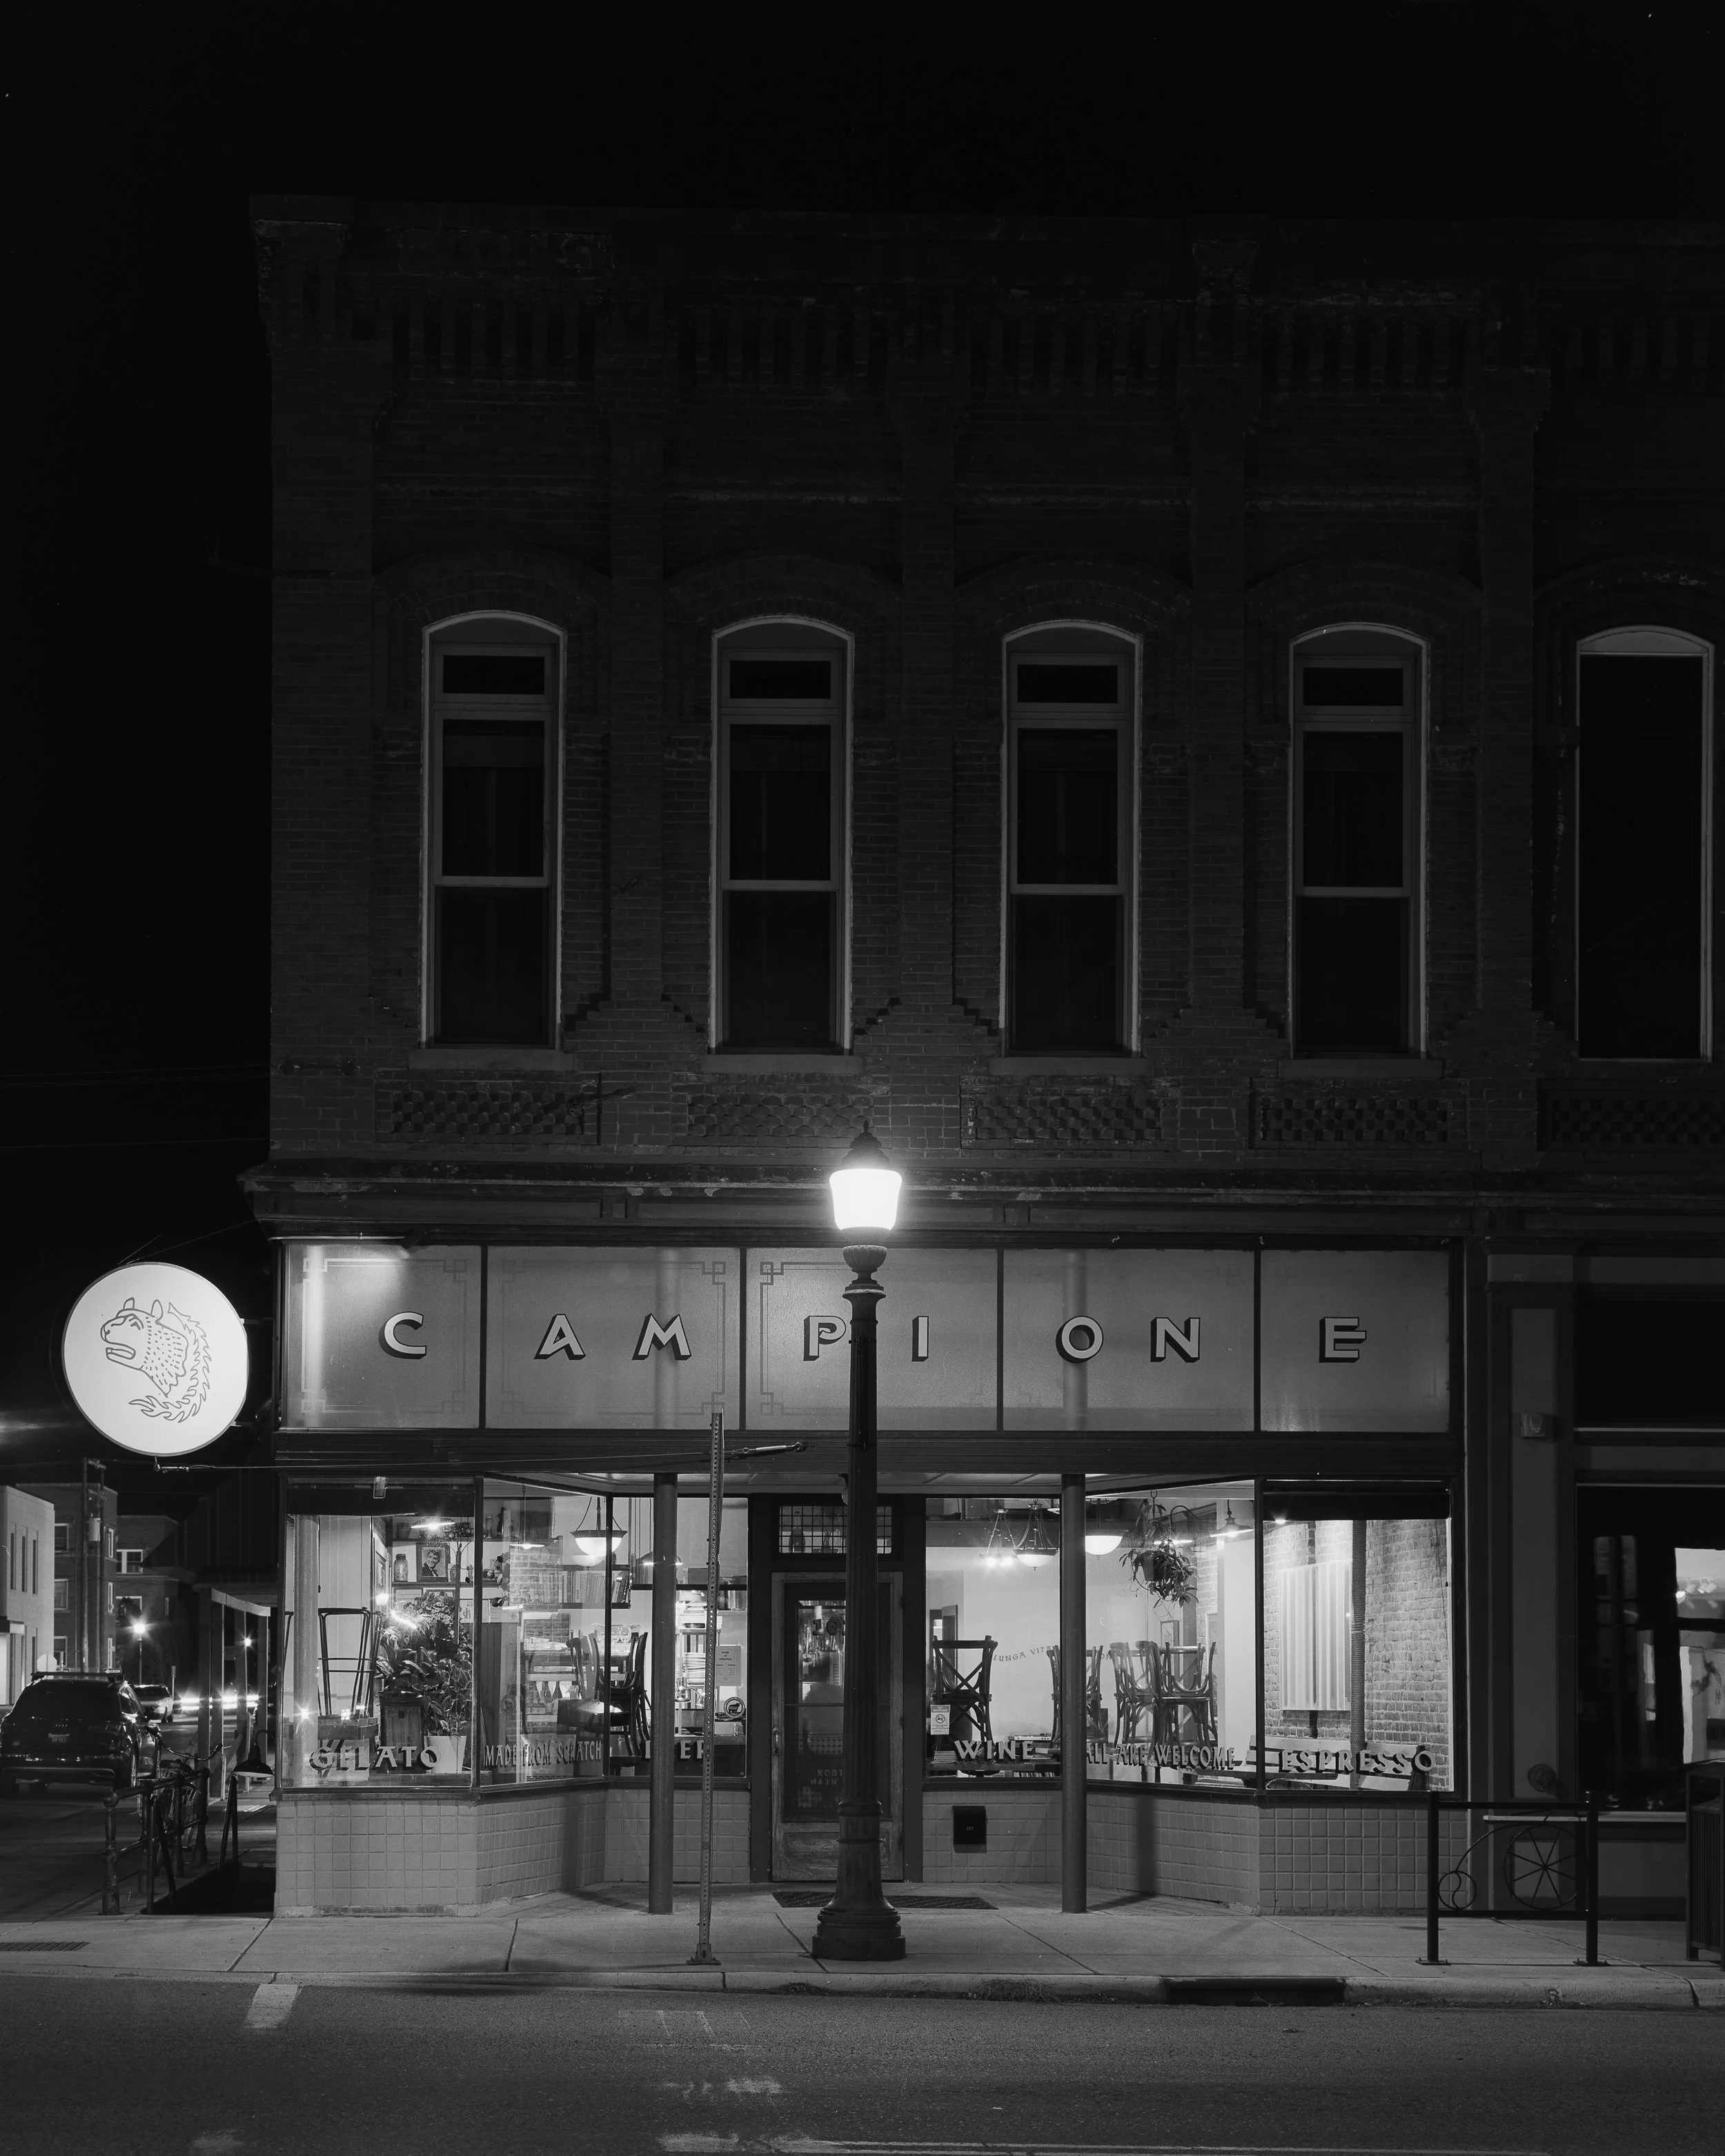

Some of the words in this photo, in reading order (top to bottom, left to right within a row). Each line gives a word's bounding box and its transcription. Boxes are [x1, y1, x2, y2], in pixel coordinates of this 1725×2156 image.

[378, 1310, 1367, 1364] CAMPIONE
[993, 1651, 1026, 1662] LUNGA
[1029, 1645, 1052, 1656] VITA
[309, 1745, 437, 1770] GELATO
[483, 1744, 517, 1768] MADE
[522, 1743, 551, 1767] FROM
[556, 1741, 602, 1765] SCRATCH
[954, 1740, 1034, 1761] WINE
[1116, 1743, 1147, 1766] ARE
[1153, 1743, 1236, 1770] WELCOME
[1278, 1749, 1435, 1774] ESPRESSO
[816, 1768, 843, 1777] NORT
